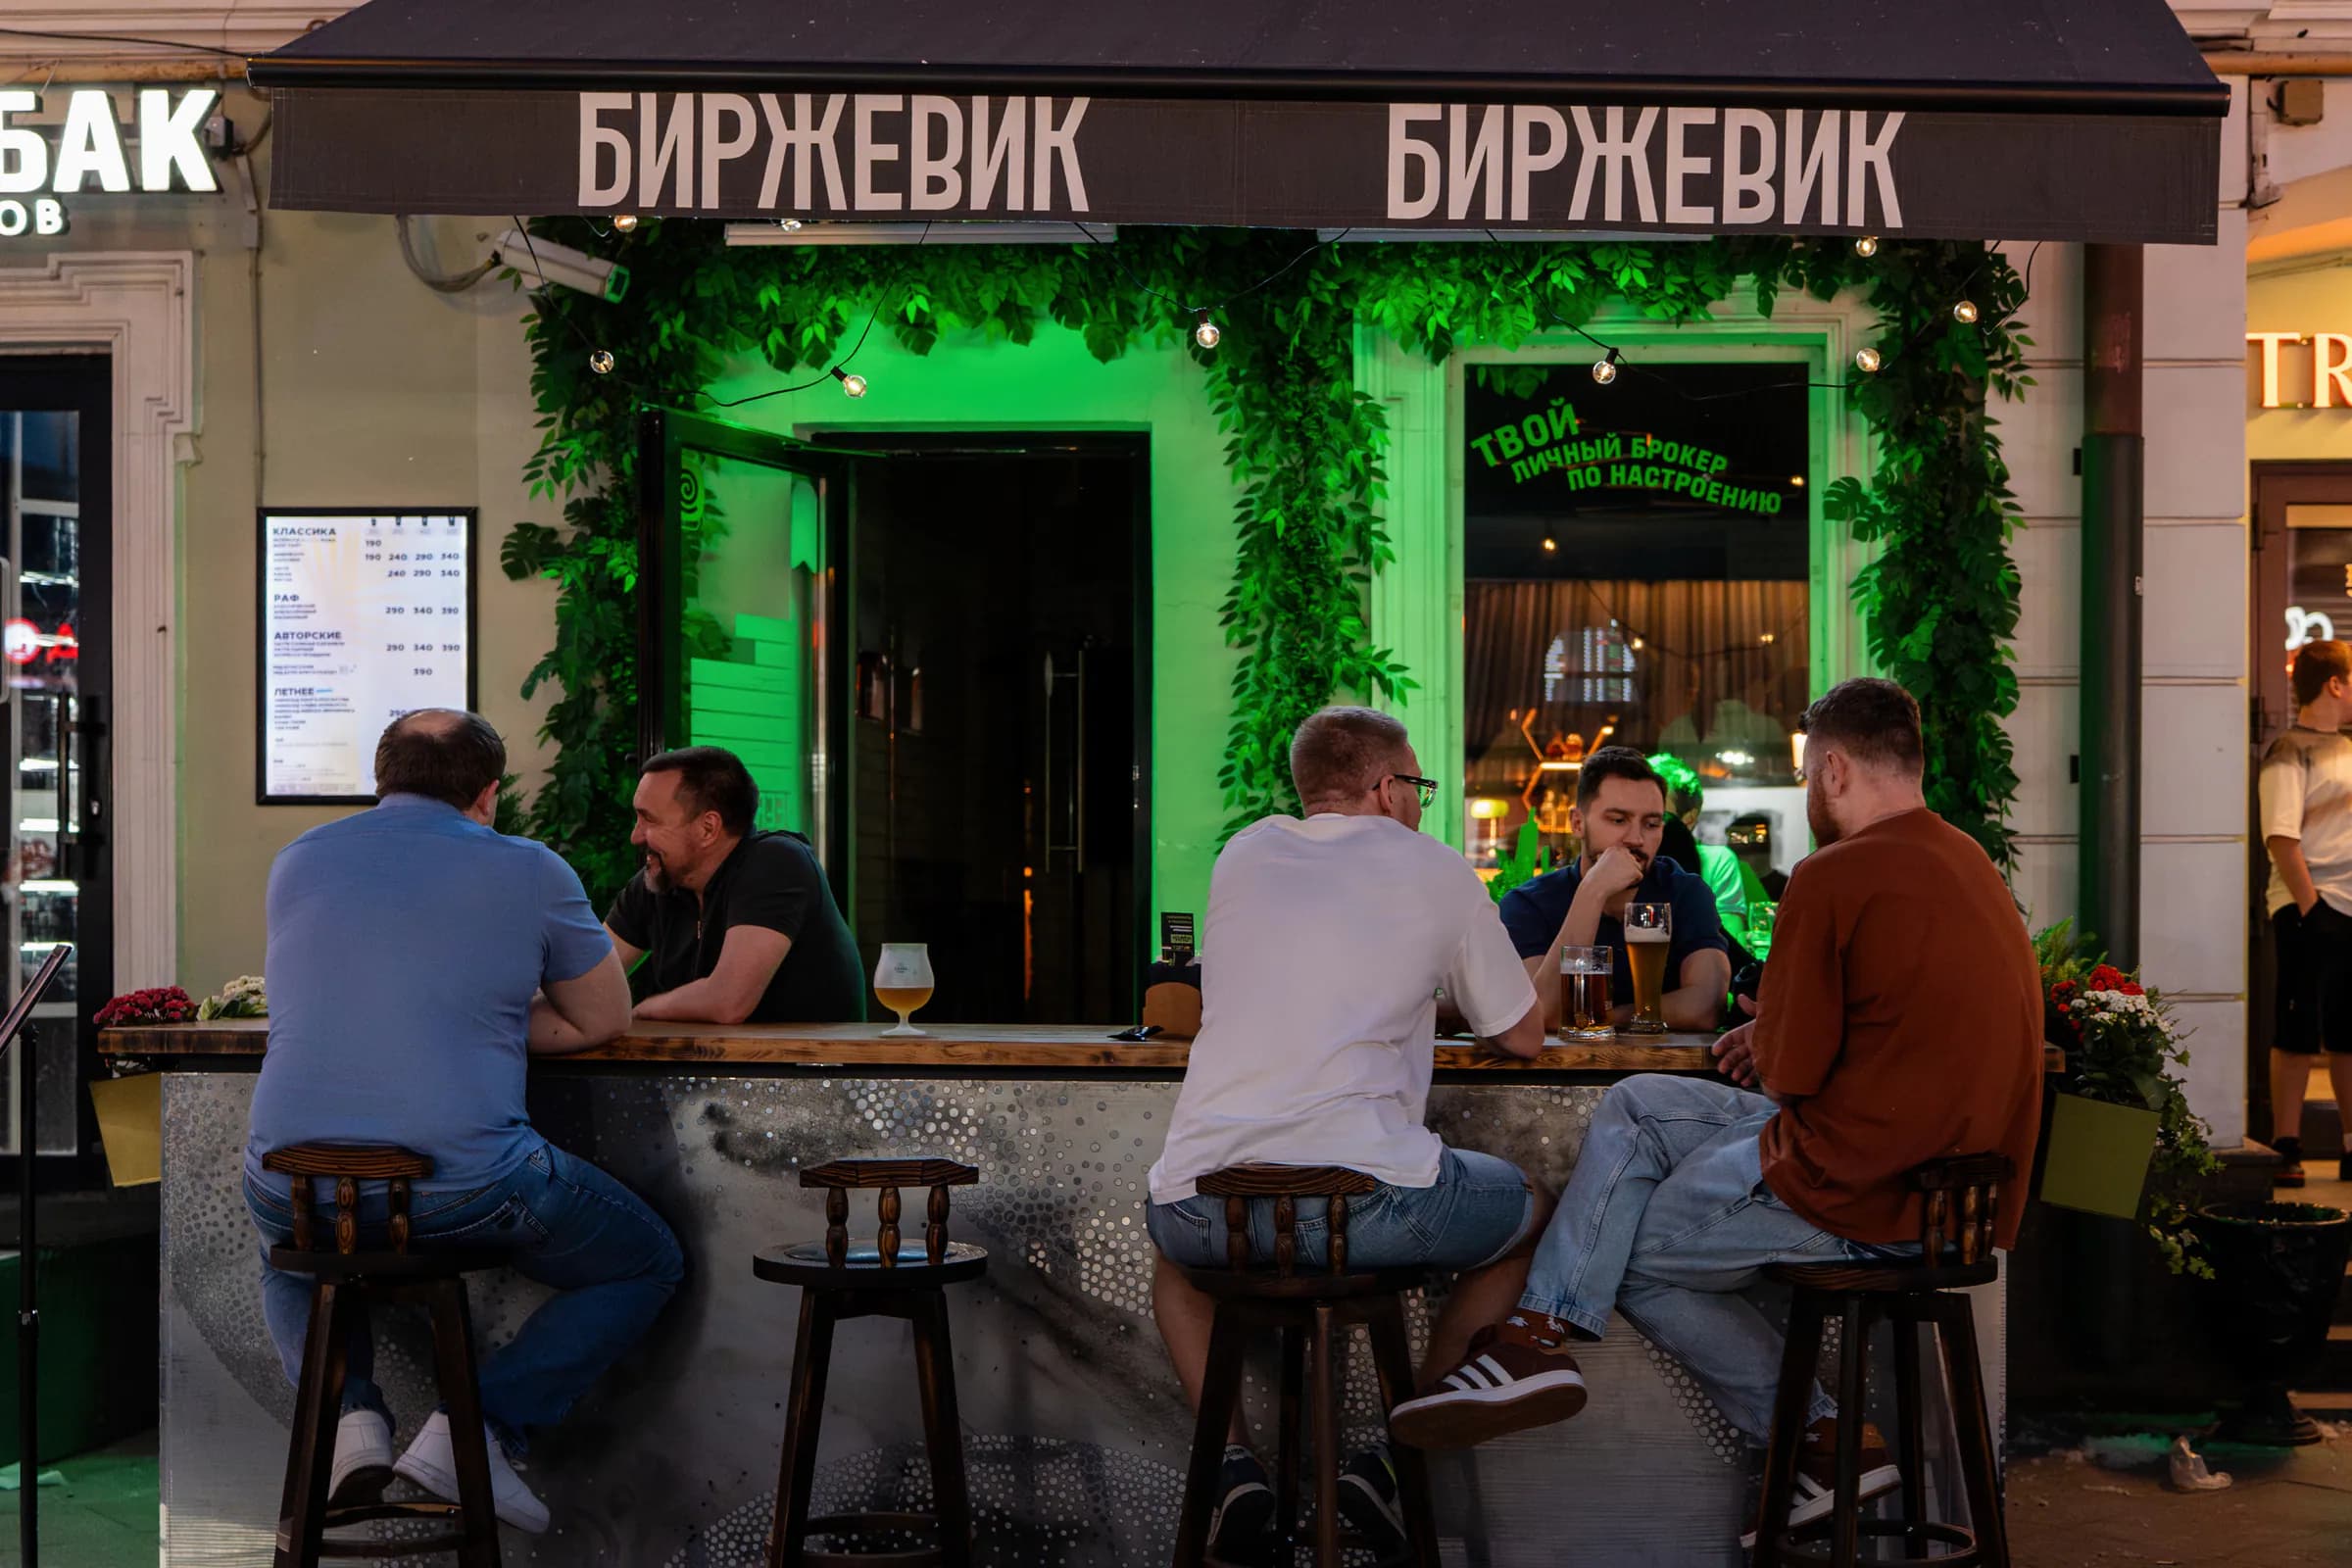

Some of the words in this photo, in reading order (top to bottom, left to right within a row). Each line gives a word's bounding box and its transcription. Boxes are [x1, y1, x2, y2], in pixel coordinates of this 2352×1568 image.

[0, 89, 218, 193] БАК
[577, 91, 1092, 213] БИРЖЕВИК
[1387, 102, 1907, 229] БИРЖЕВИК
[2245, 331, 2352, 408] TR
[1471, 396, 1580, 467] ТВОЙ
[1511, 432, 1621, 483] ЛИЧНЫЙ
[1631, 437, 1728, 474] БРОКЕР
[1567, 465, 1602, 491] ПО
[1610, 464, 1782, 514] НАСТРОЕНИЮ
[272, 527, 336, 536] КЛАССИКА
[274, 631, 342, 640] АВТОРСКИЕ
[274, 687, 315, 696] ЛЕТНЕЕ
